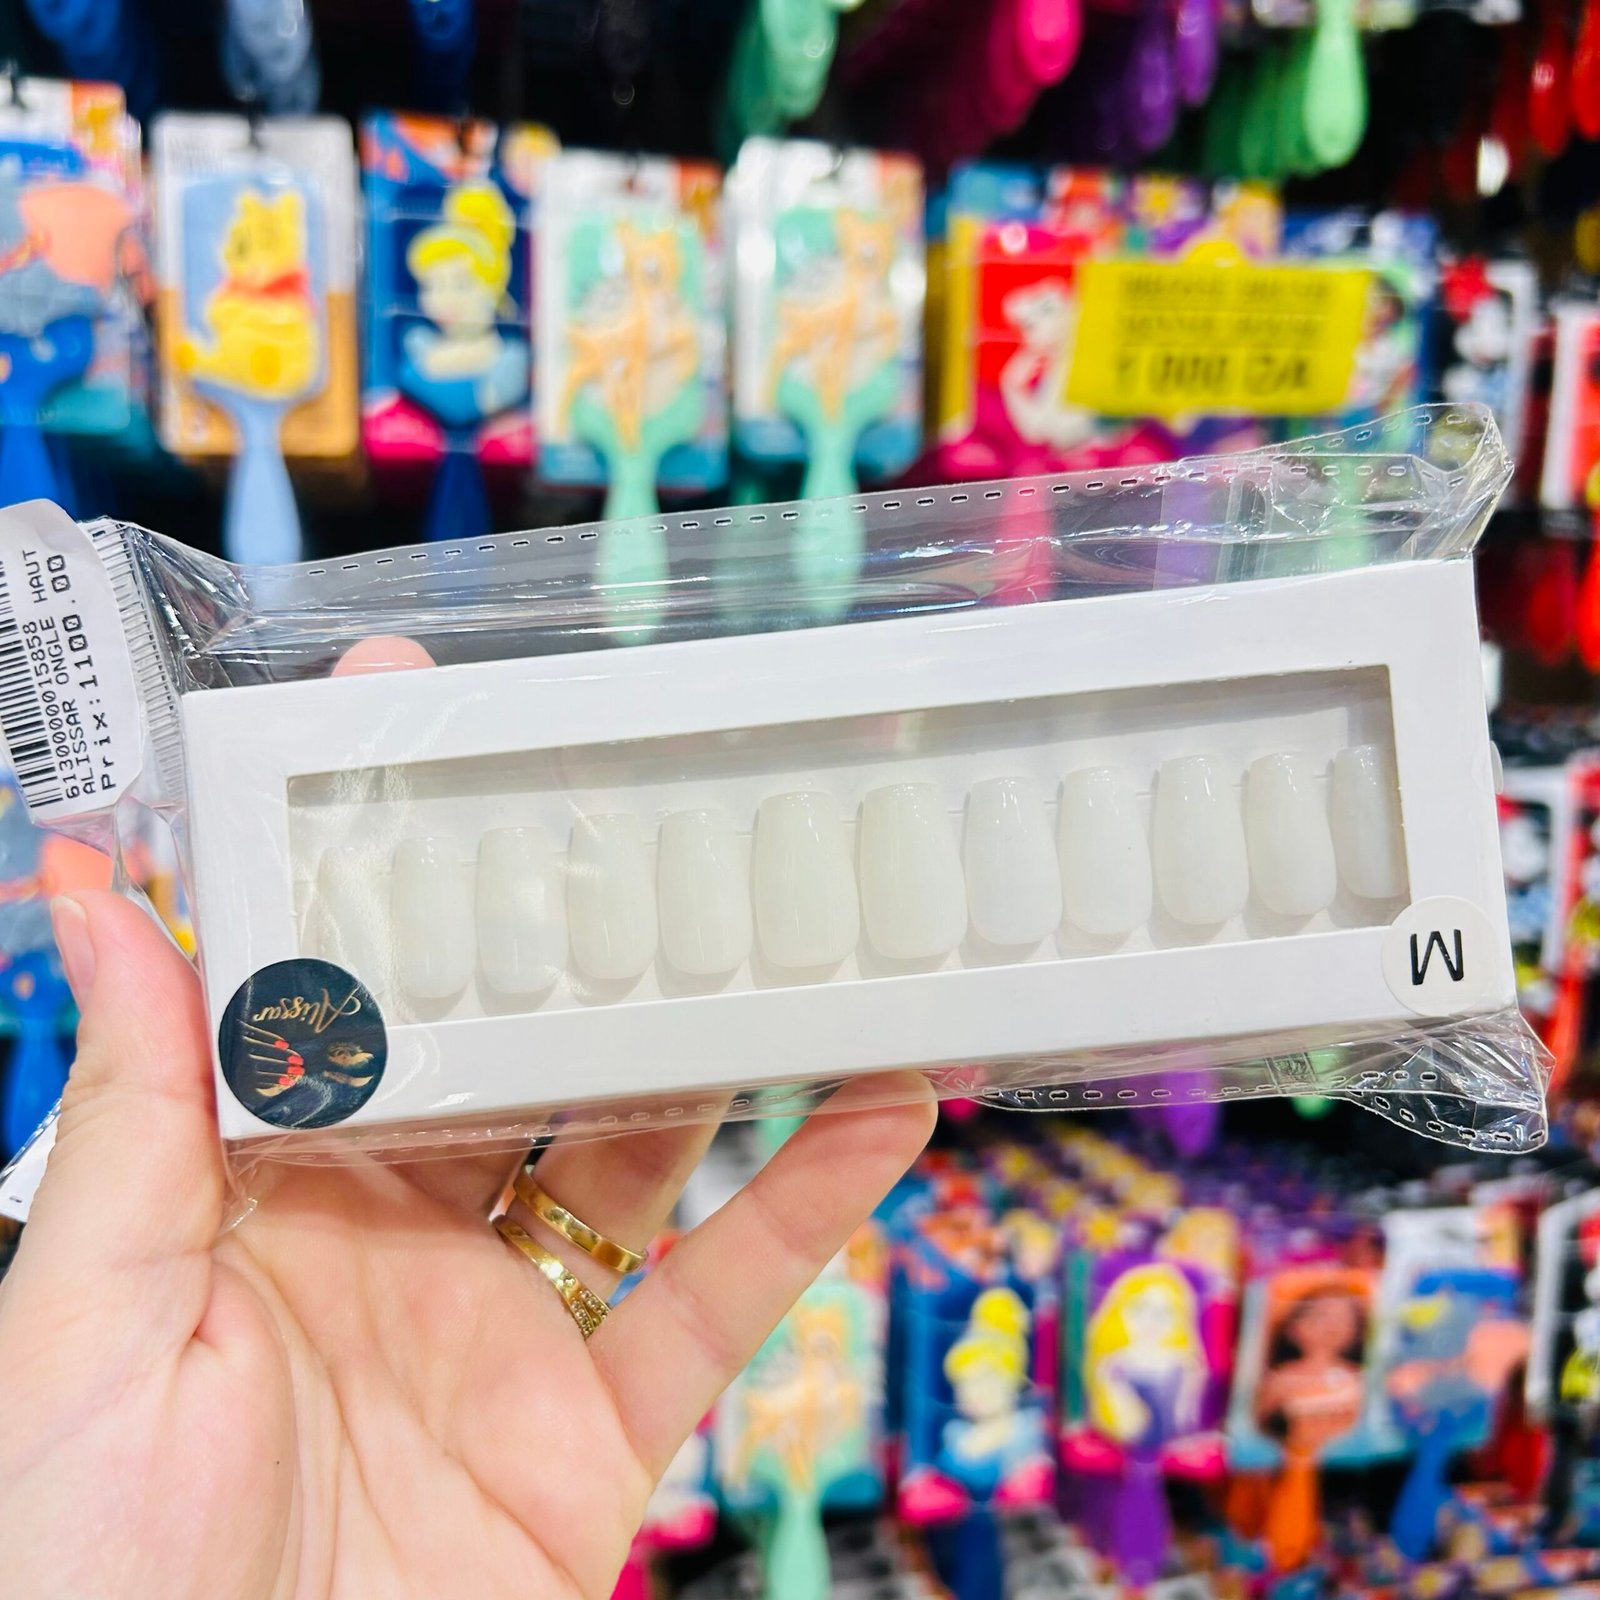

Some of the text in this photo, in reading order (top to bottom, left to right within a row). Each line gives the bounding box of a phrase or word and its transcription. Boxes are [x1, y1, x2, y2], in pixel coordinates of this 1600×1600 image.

[22, 550, 96, 794] ALISSAR ONGLE HAUT
[22, 621, 80, 799] 6130000015858
[253, 987, 361, 1034] Alissar
[1410, 929, 1464, 985] M
